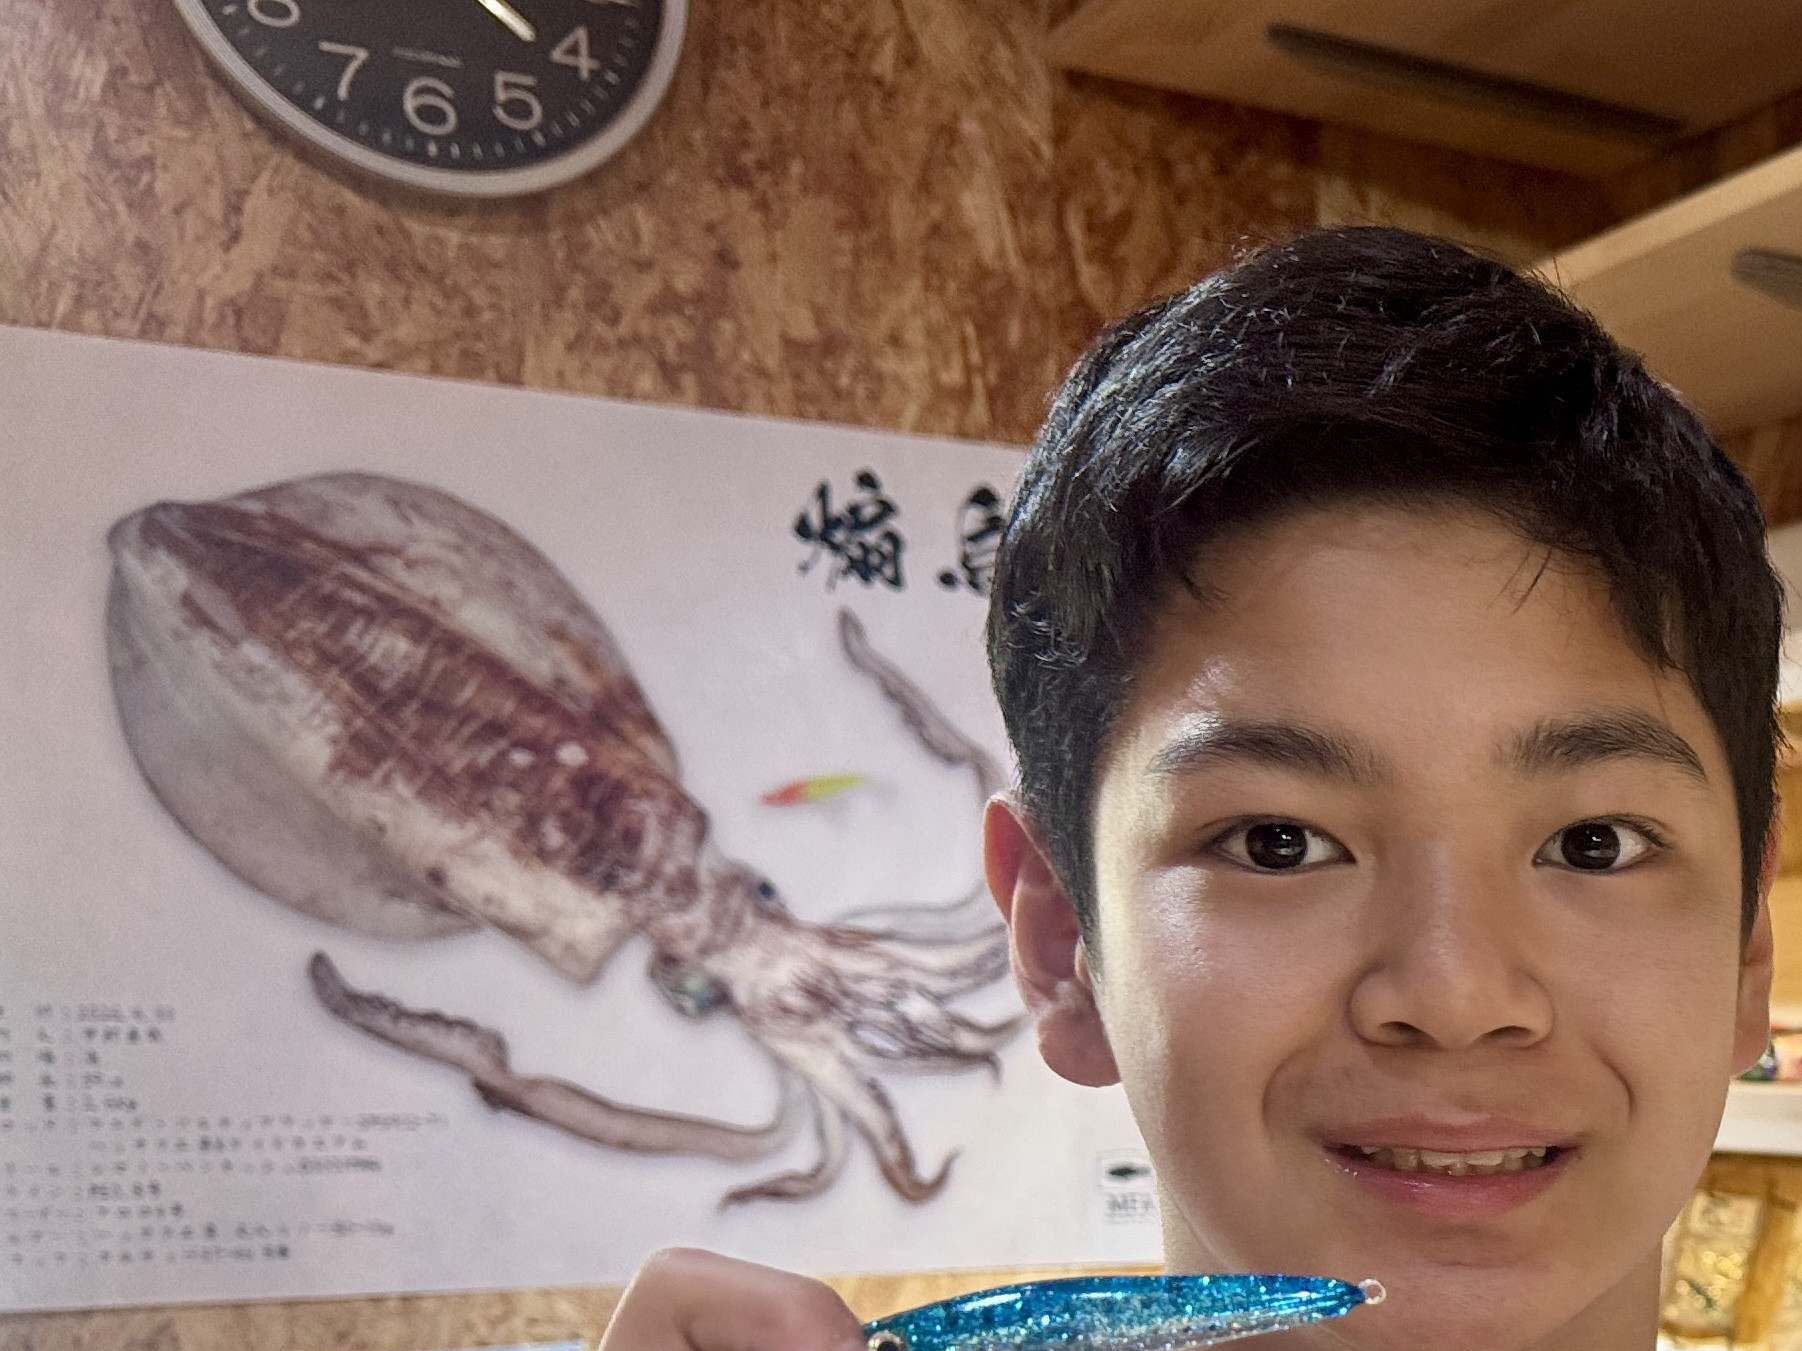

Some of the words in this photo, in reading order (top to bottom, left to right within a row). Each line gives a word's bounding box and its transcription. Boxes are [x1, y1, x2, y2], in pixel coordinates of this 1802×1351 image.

[318, 41, 369, 100] 7
[549, 25, 599, 81] 4
[402, 76, 458, 136] 6
[491, 70, 544, 130] 5
